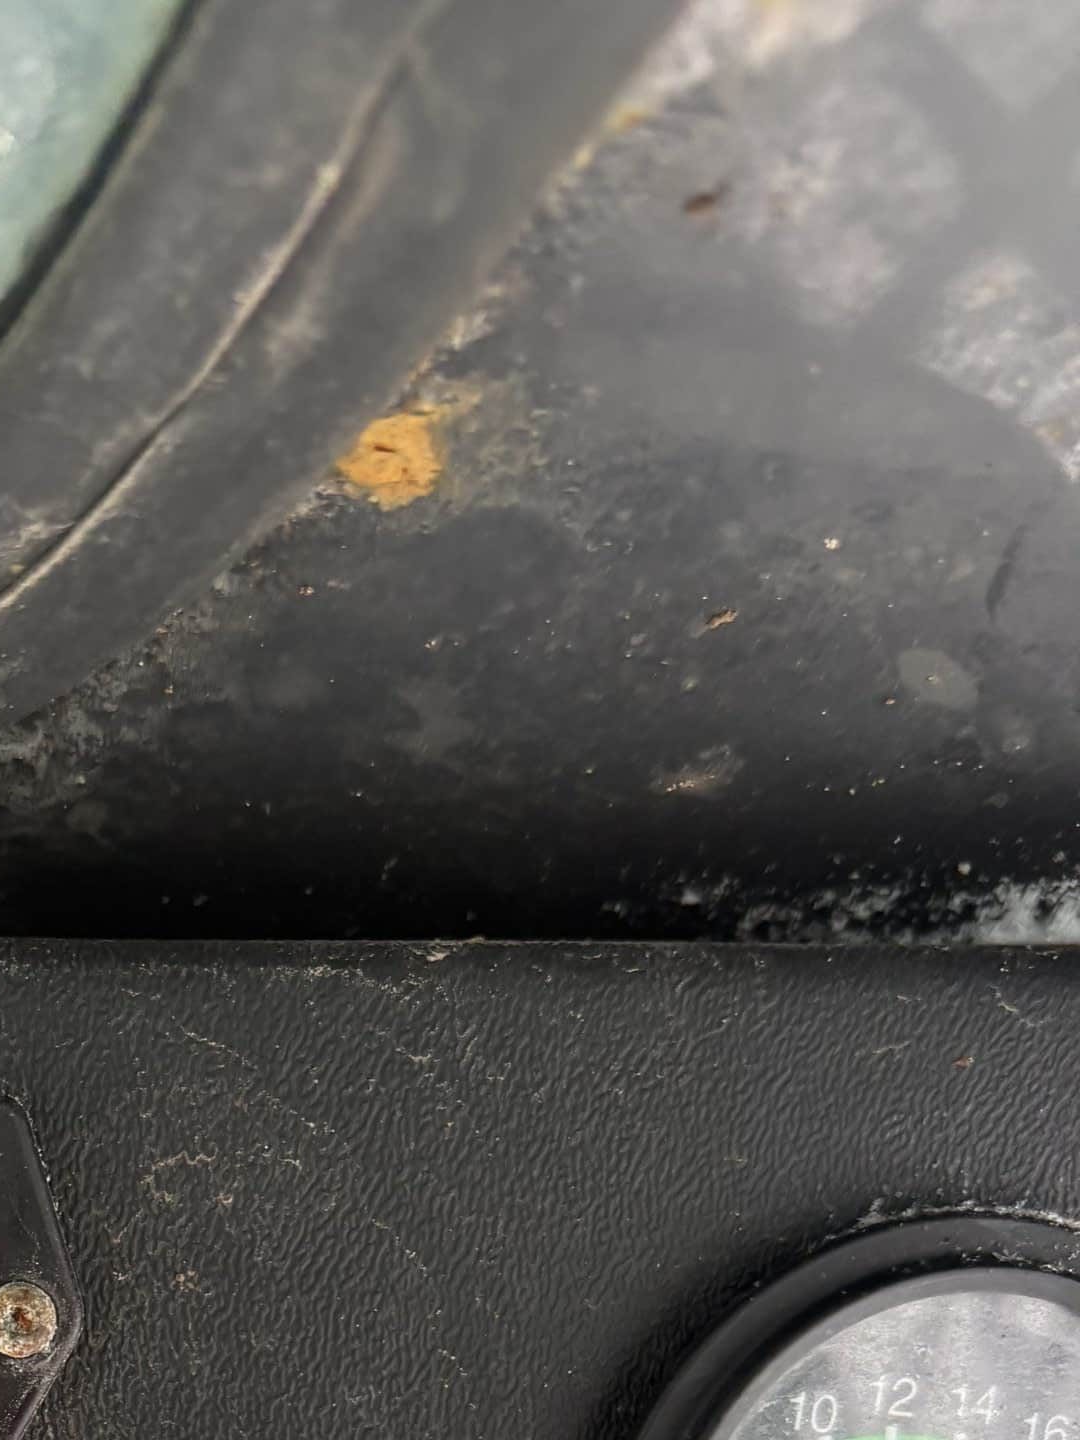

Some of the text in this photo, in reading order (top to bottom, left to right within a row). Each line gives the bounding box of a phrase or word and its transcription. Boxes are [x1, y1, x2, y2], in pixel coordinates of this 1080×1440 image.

[791, 1390, 839, 1433] 10
[870, 1377, 919, 1418] 12
[950, 1385, 999, 1425] 14
